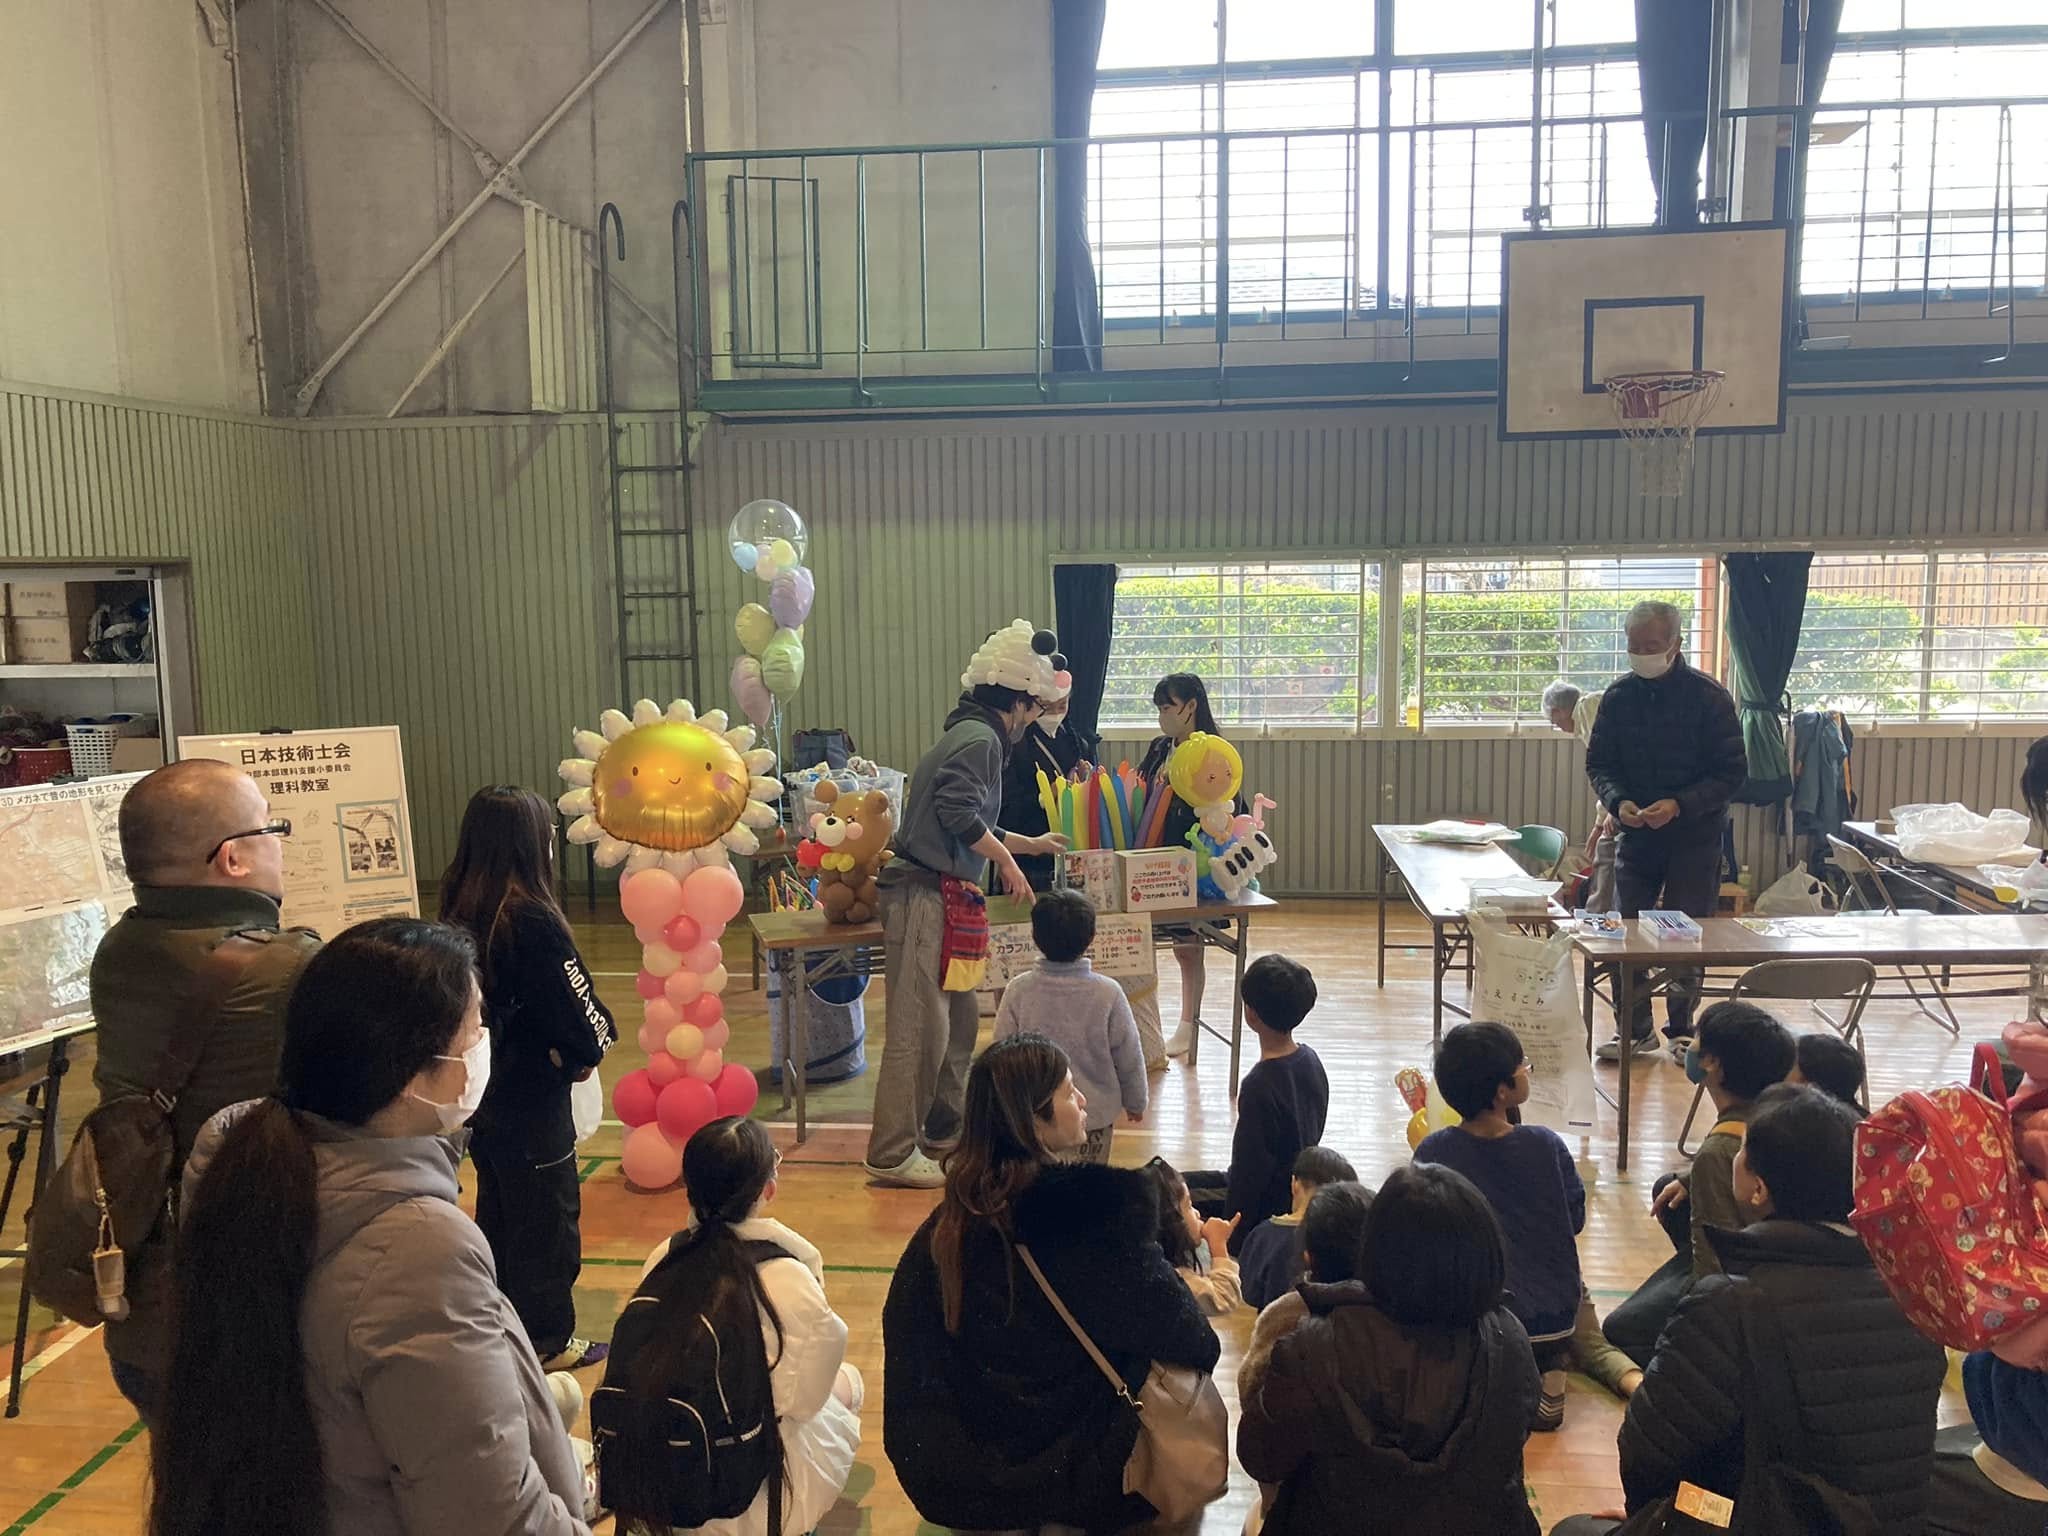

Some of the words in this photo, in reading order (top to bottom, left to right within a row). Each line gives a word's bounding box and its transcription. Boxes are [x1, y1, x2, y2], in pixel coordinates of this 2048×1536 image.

[241, 742, 352, 765] 日本技術士会
[270, 779, 331, 795] 理科教室
[1, 797, 13, 807] 3D
[563, 957, 589, 998] YOU?
